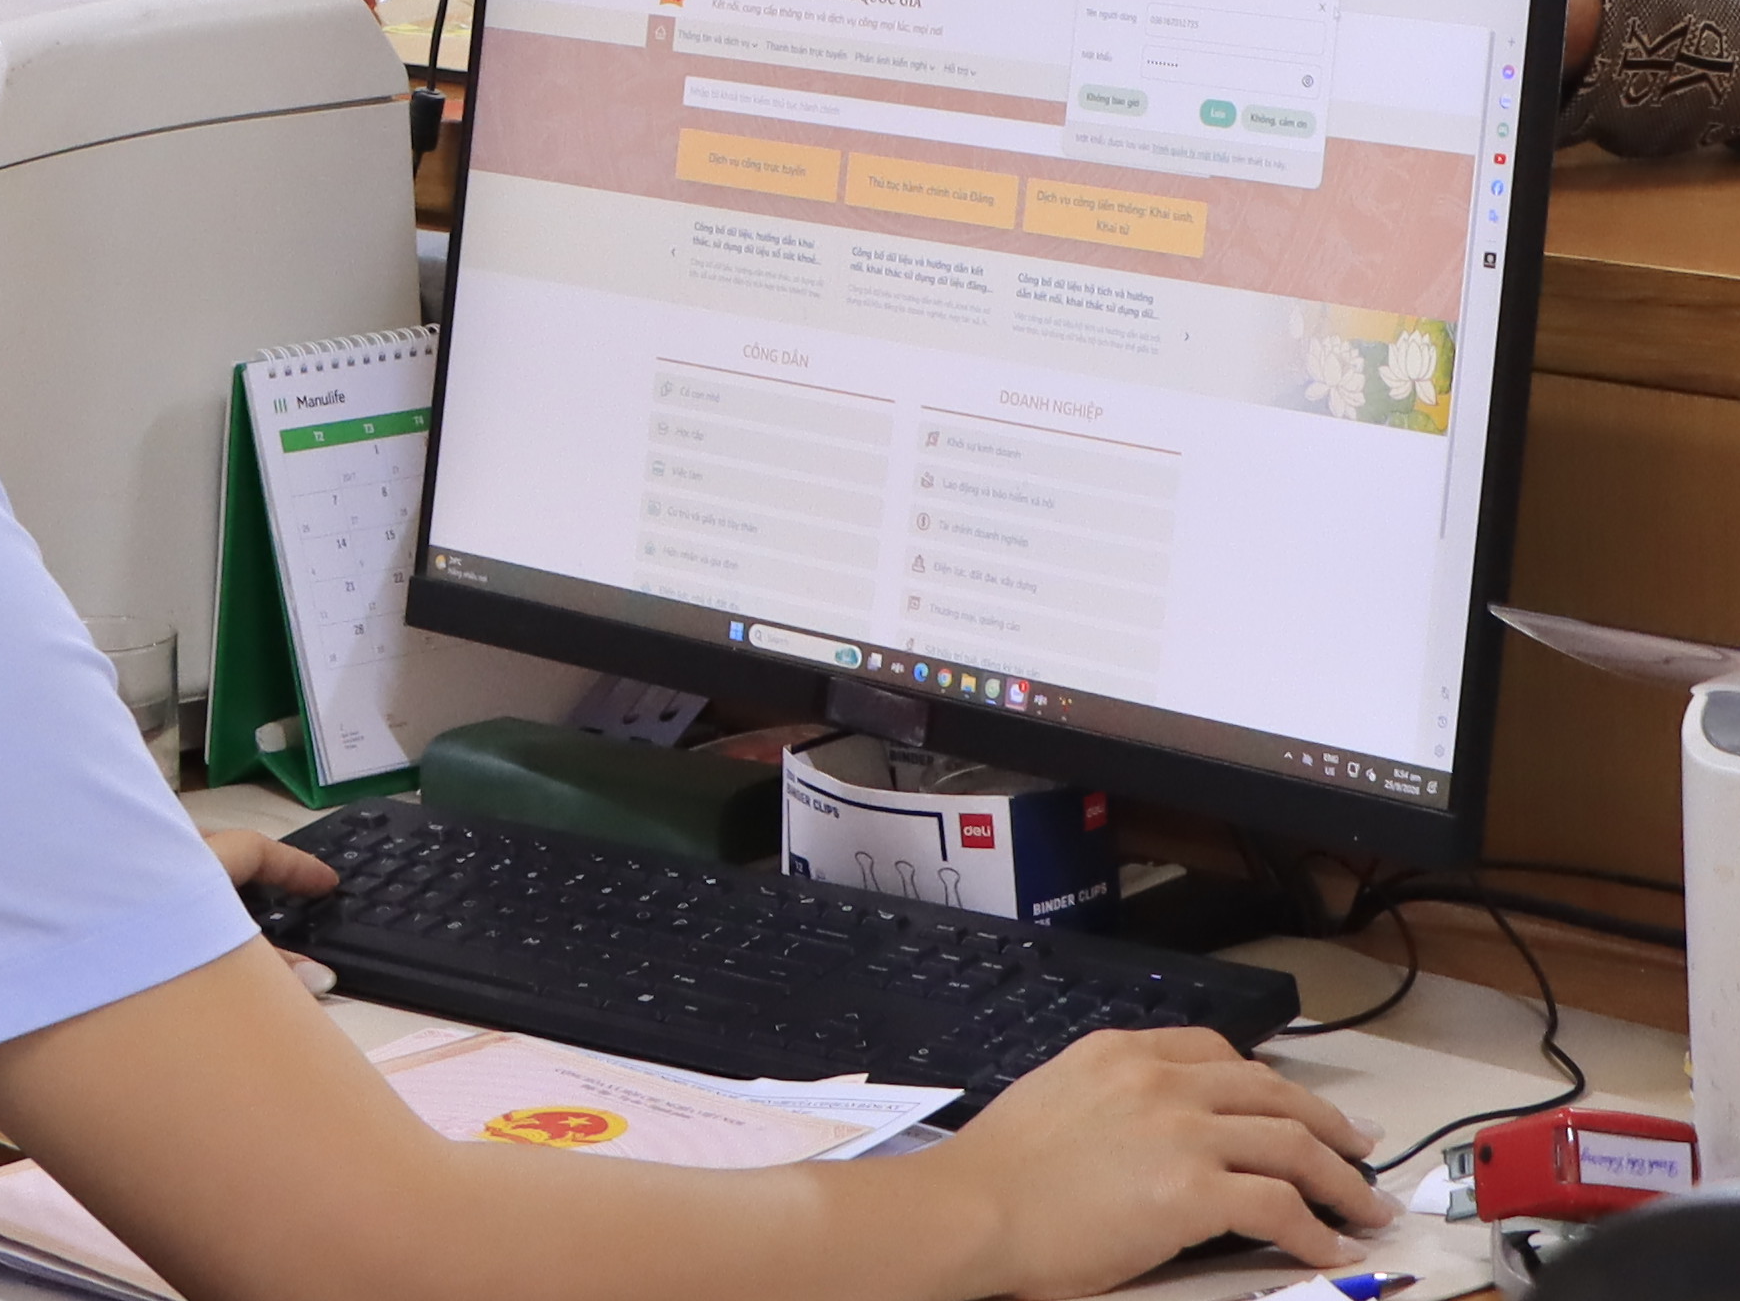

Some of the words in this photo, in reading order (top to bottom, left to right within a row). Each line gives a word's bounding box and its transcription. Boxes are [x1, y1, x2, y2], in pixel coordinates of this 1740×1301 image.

[743, 342, 778, 364] CÔNG
[781, 348, 809, 368] DÂN
[296, 390, 346, 410] Manulife
[999, 389, 1050, 412] DOANH
[1052, 400, 1104, 424] NGHIỆP
[336, 537, 348, 549] 14
[385, 529, 396, 542] 15
[813, 797, 841, 820] CLIPS
[963, 825, 991, 837] deli
[1032, 893, 1076, 917] BINDER
[1077, 883, 1108, 905] CLIPS
